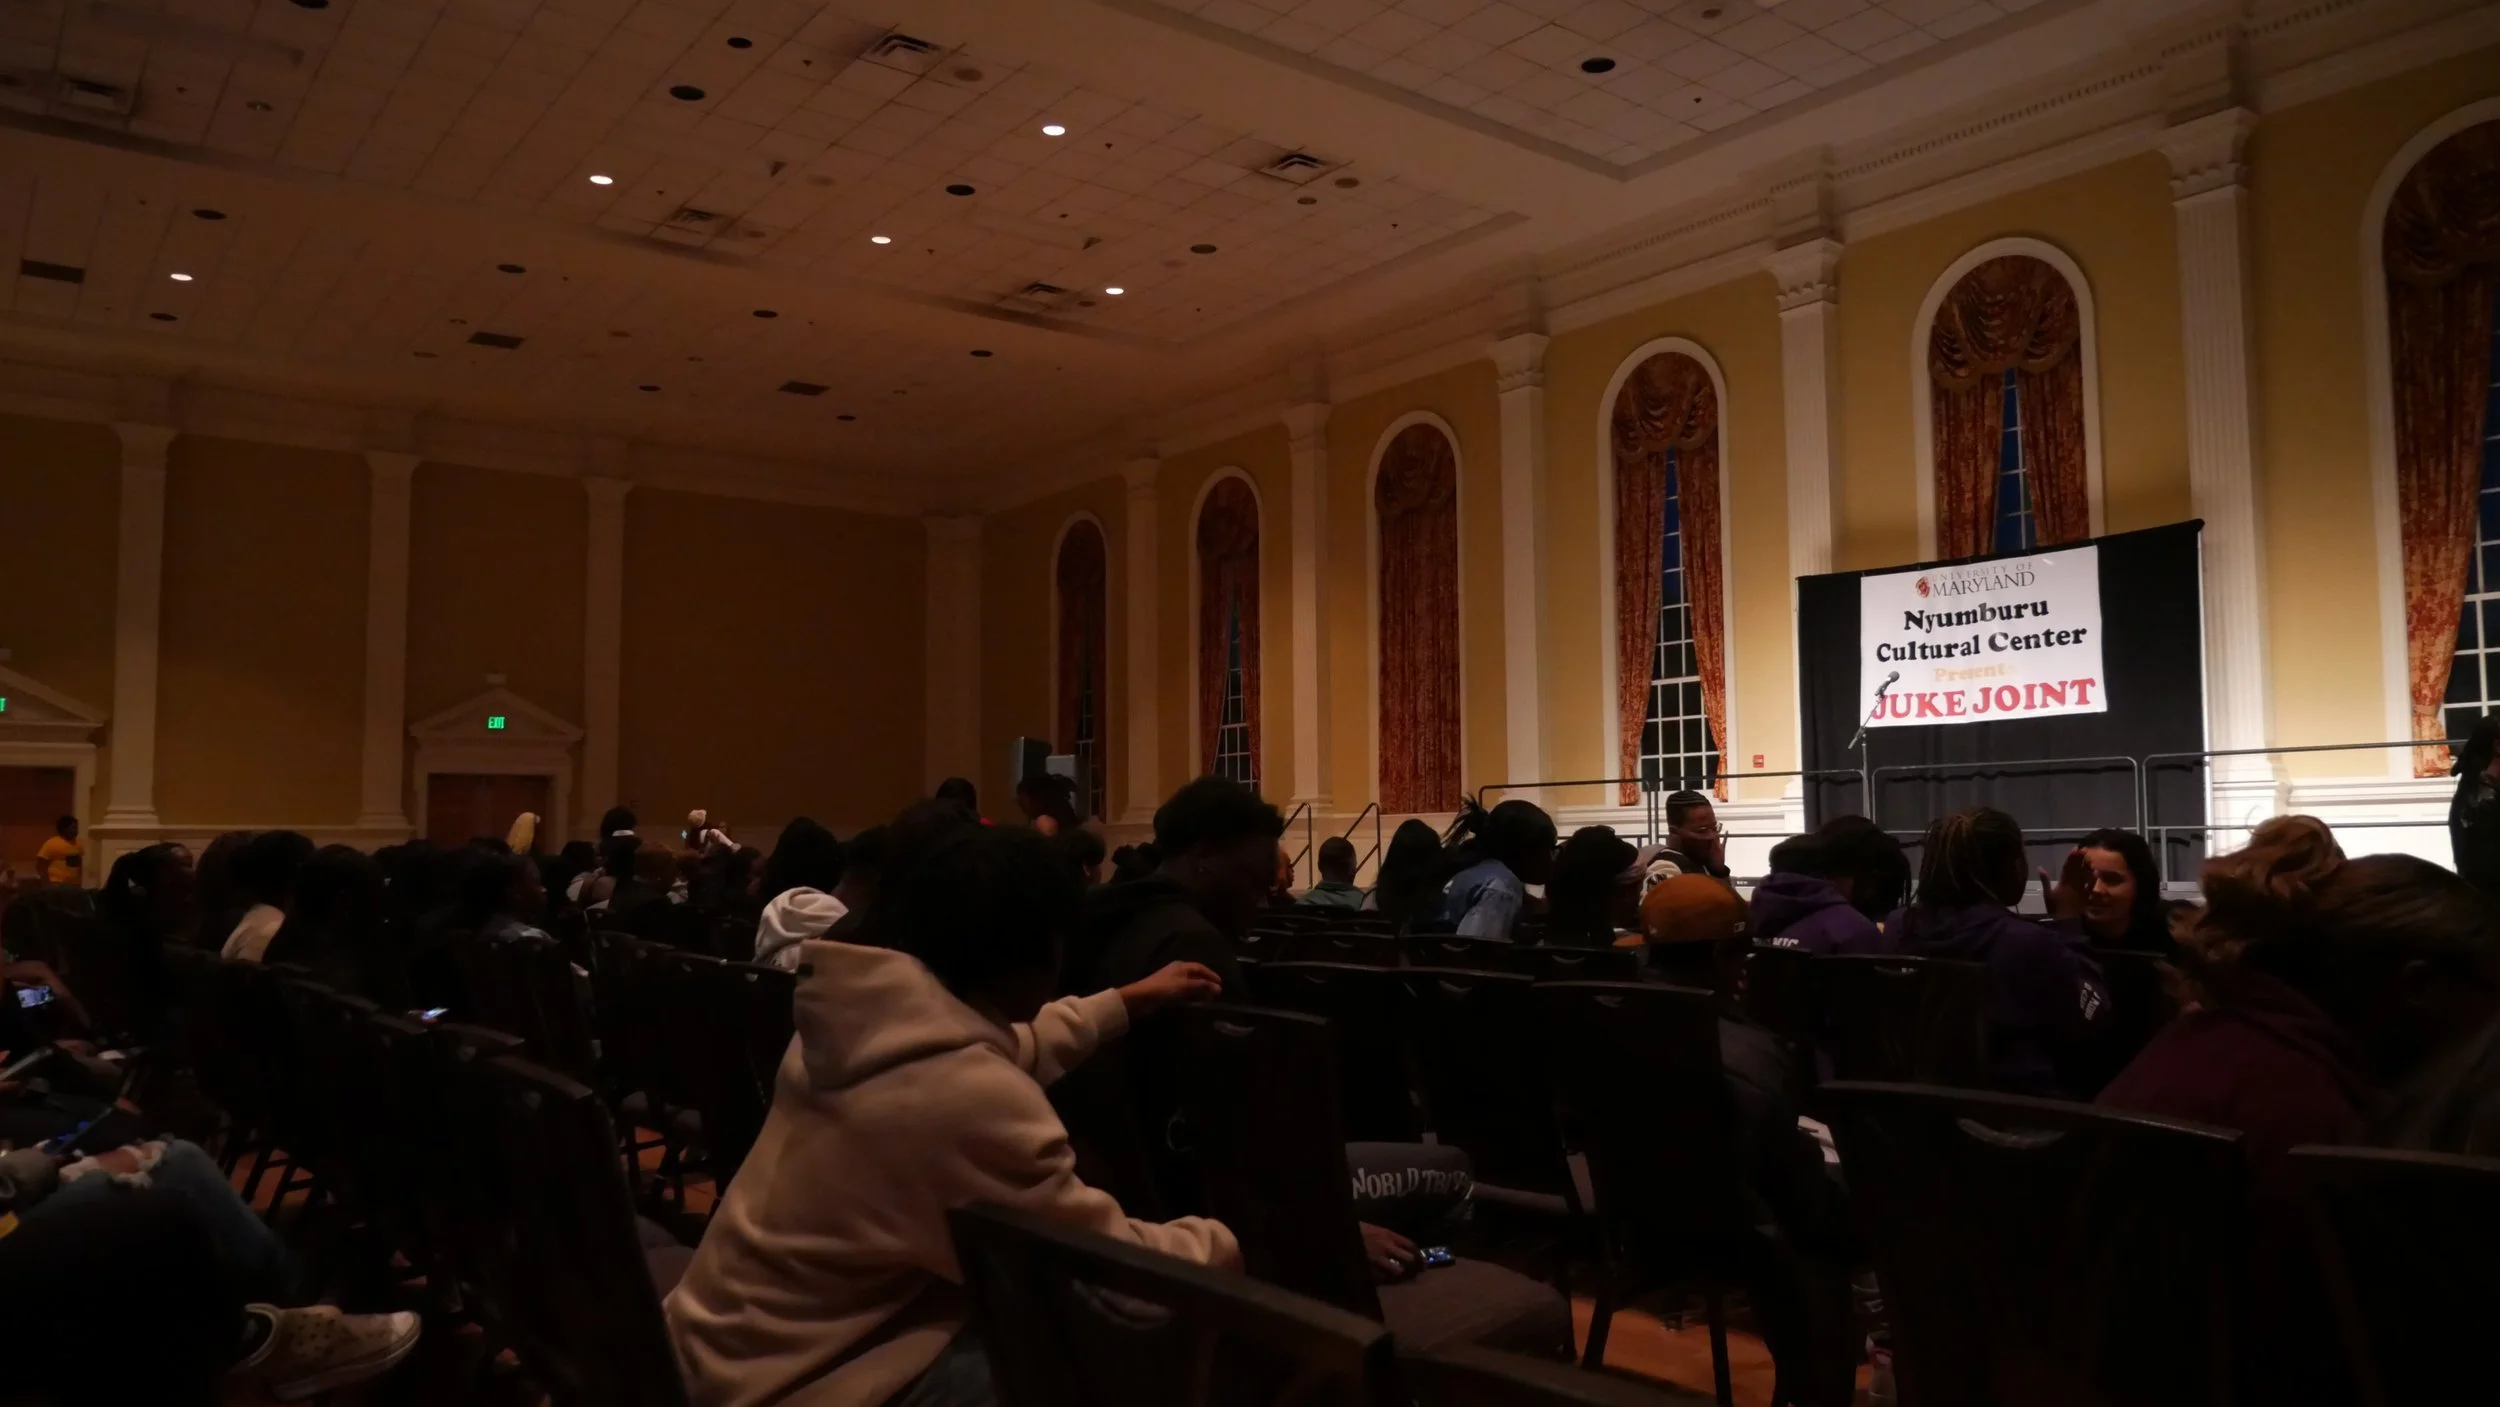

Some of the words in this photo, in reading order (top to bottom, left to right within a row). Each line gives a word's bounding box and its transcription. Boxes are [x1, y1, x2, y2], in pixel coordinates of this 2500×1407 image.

[1932, 564, 2008, 582] UNIVERSITY
[2016, 561, 2034, 572] OF
[1933, 571, 2036, 597] MARYLAND
[1903, 600, 2049, 633] Nyumburu
[1876, 635, 1980, 662] Cultural
[1988, 627, 2088, 652] Center
[1871, 690, 1967, 720] JUKE
[1972, 678, 2096, 714] JOINT
[488, 716, 506, 729] EXIT
